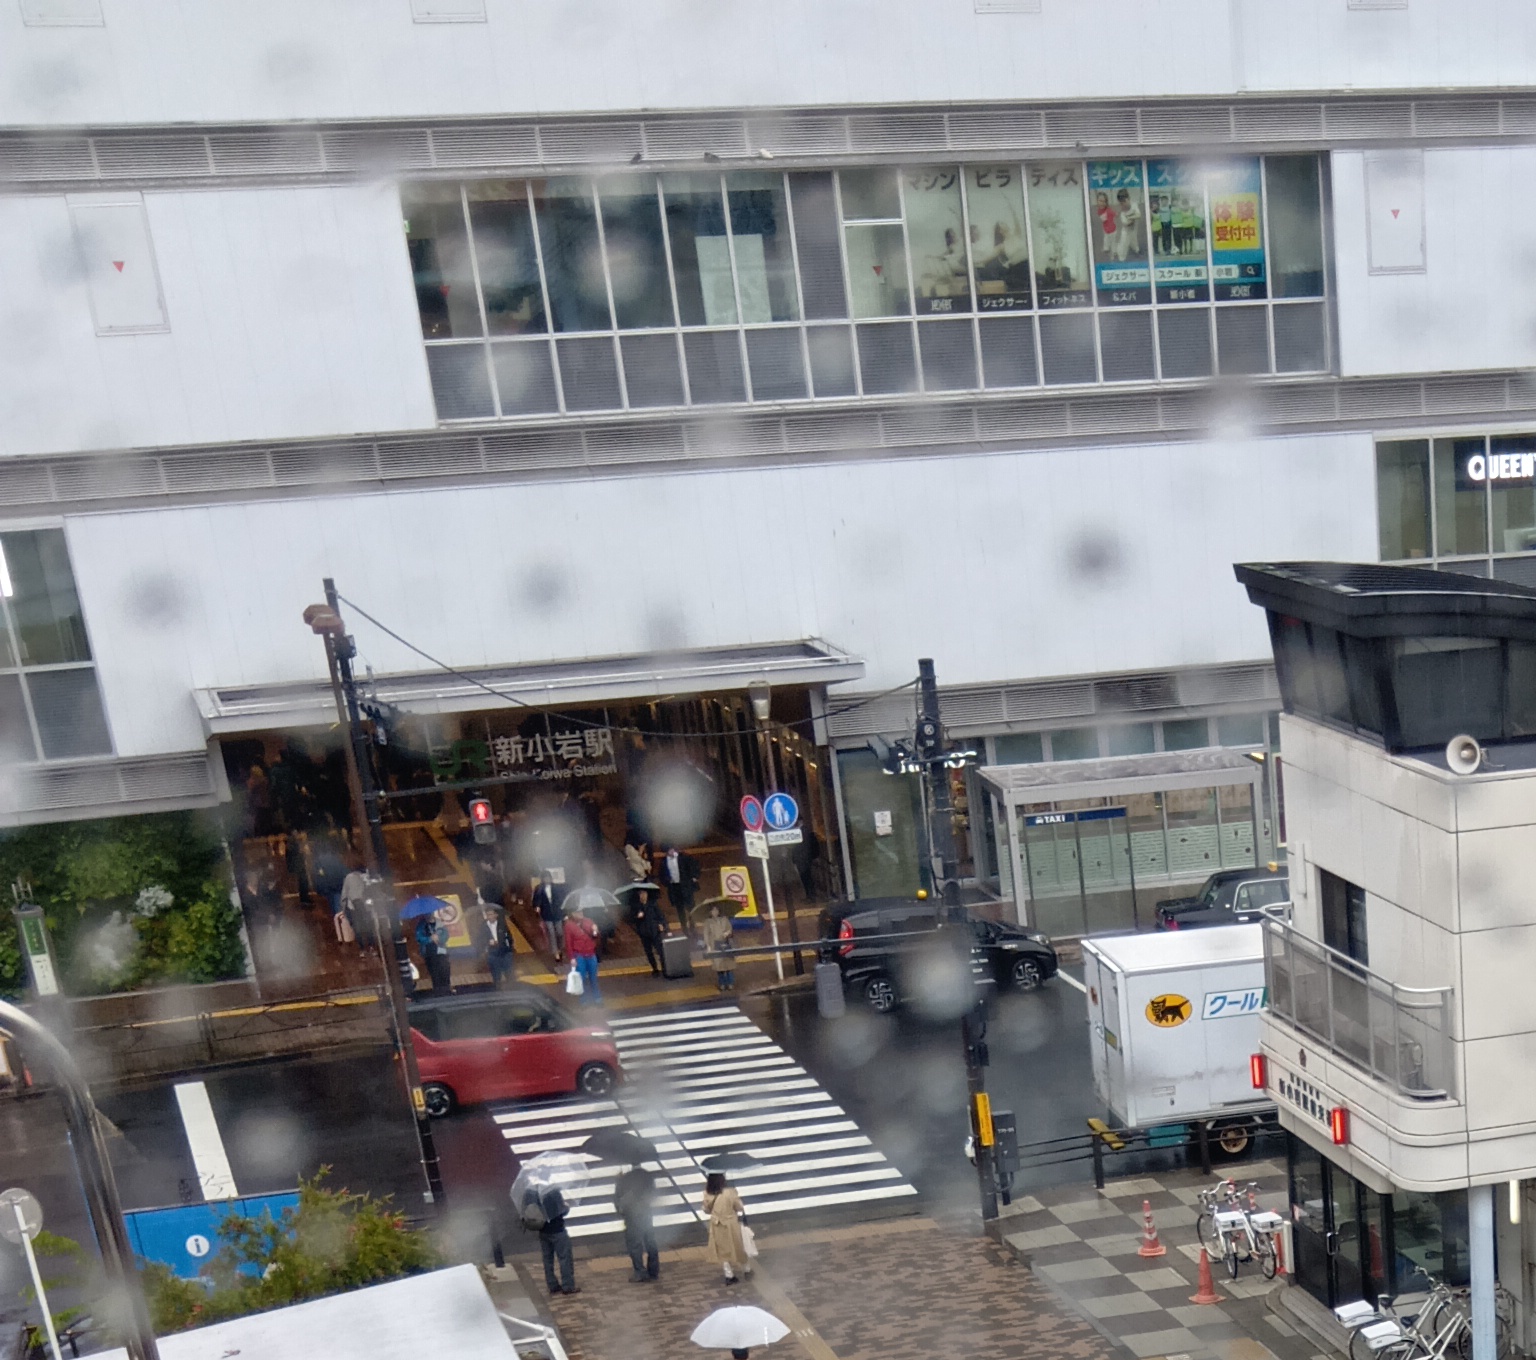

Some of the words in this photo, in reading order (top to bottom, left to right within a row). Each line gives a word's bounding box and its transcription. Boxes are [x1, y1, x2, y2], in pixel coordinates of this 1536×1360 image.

[1214, 201, 1255, 223] 体験
[1215, 225, 1256, 242] 受付中
[495, 728, 614, 766] 新小岩駅
[1044, 814, 1066, 824] TAXI
[1209, 991, 1260, 1016] クール
